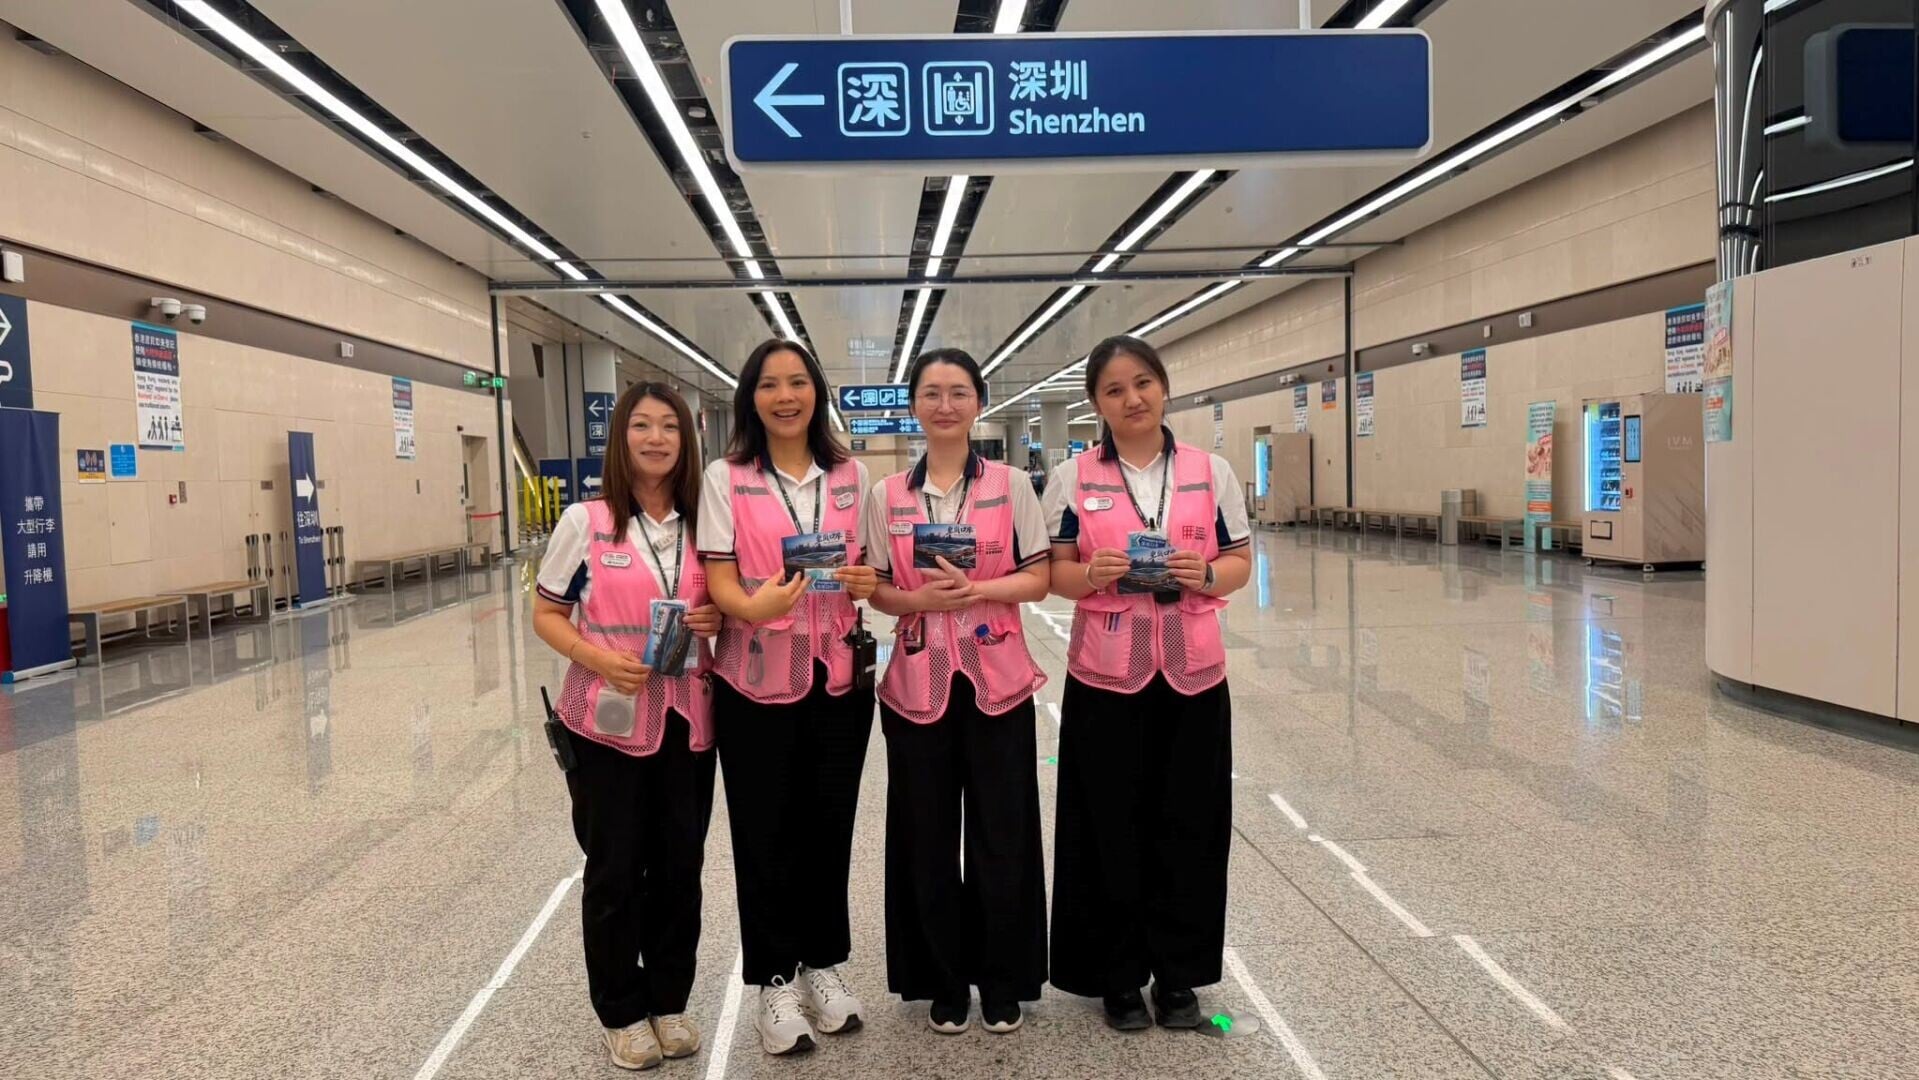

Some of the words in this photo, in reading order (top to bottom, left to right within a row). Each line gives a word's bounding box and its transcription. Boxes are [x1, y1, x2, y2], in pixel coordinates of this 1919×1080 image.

[1008, 60, 1088, 102] 深圳
[848, 74, 901, 128] 深
[1009, 107, 1146, 135] Shenzhen
[25, 495, 44, 512] 攜帶
[17, 518, 56, 534] 大型行李
[297, 510, 319, 528] 往深圳
[27, 542, 47, 558] 請用
[24, 567, 54, 585] 升降機
